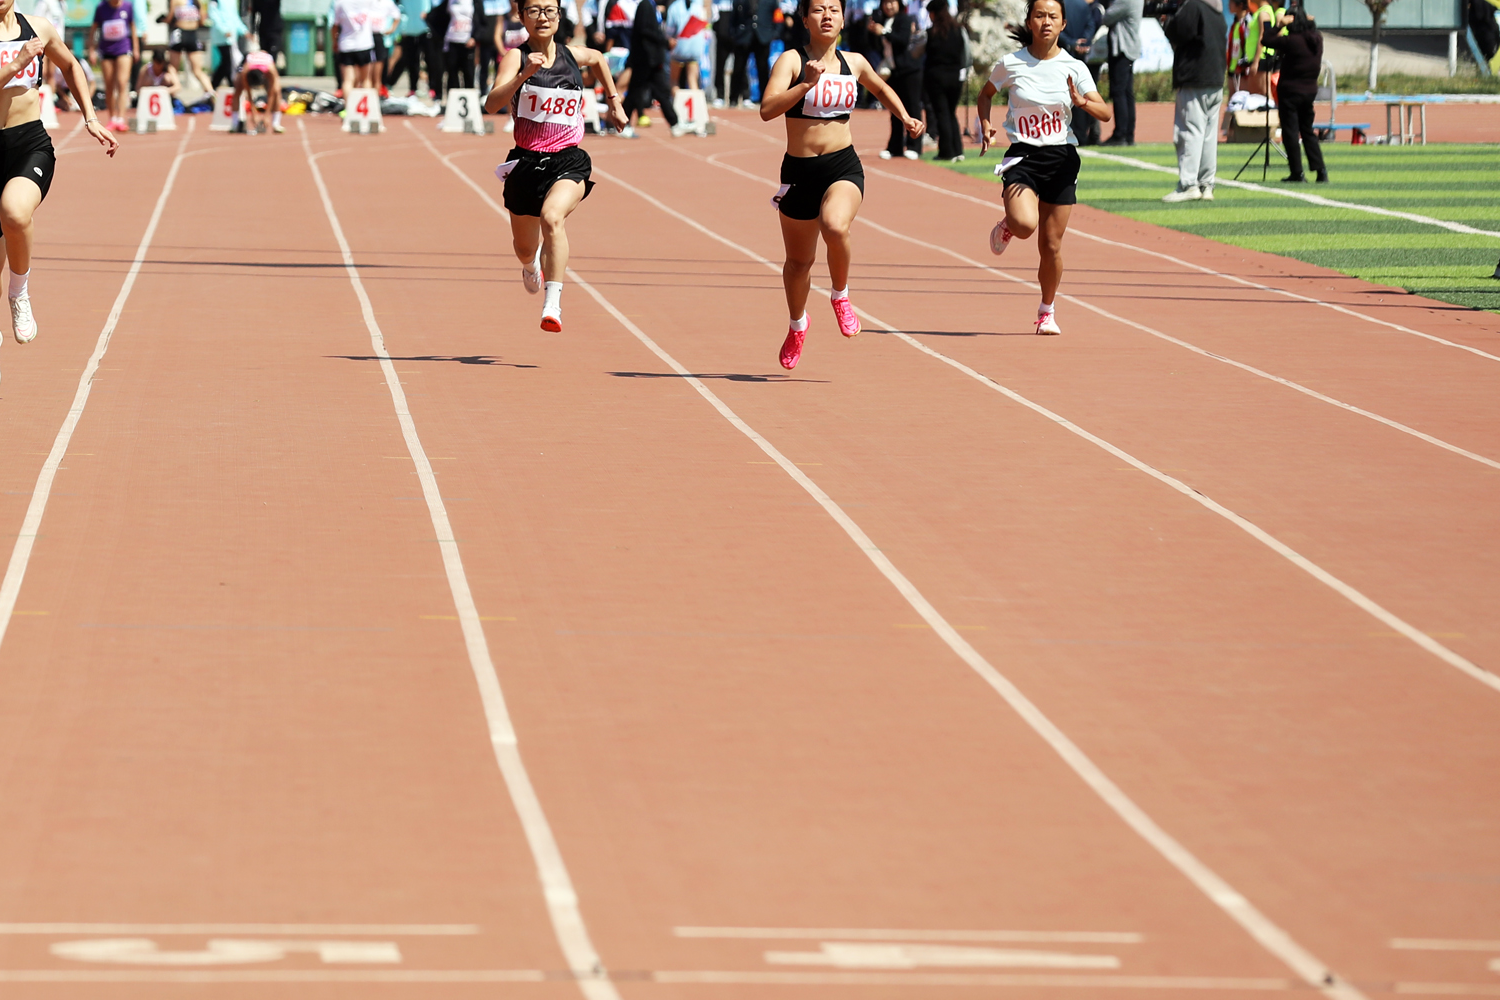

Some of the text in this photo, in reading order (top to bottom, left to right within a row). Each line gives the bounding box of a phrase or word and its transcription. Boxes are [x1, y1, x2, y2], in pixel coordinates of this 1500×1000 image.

[149, 93, 161, 116] 6
[528, 94, 578, 117] 1488
[812, 79, 855, 109] 1678
[356, 95, 369, 117] 4
[458, 96, 469, 118] 3
[684, 97, 693, 121] 1
[1018, 110, 1062, 139] 0366
